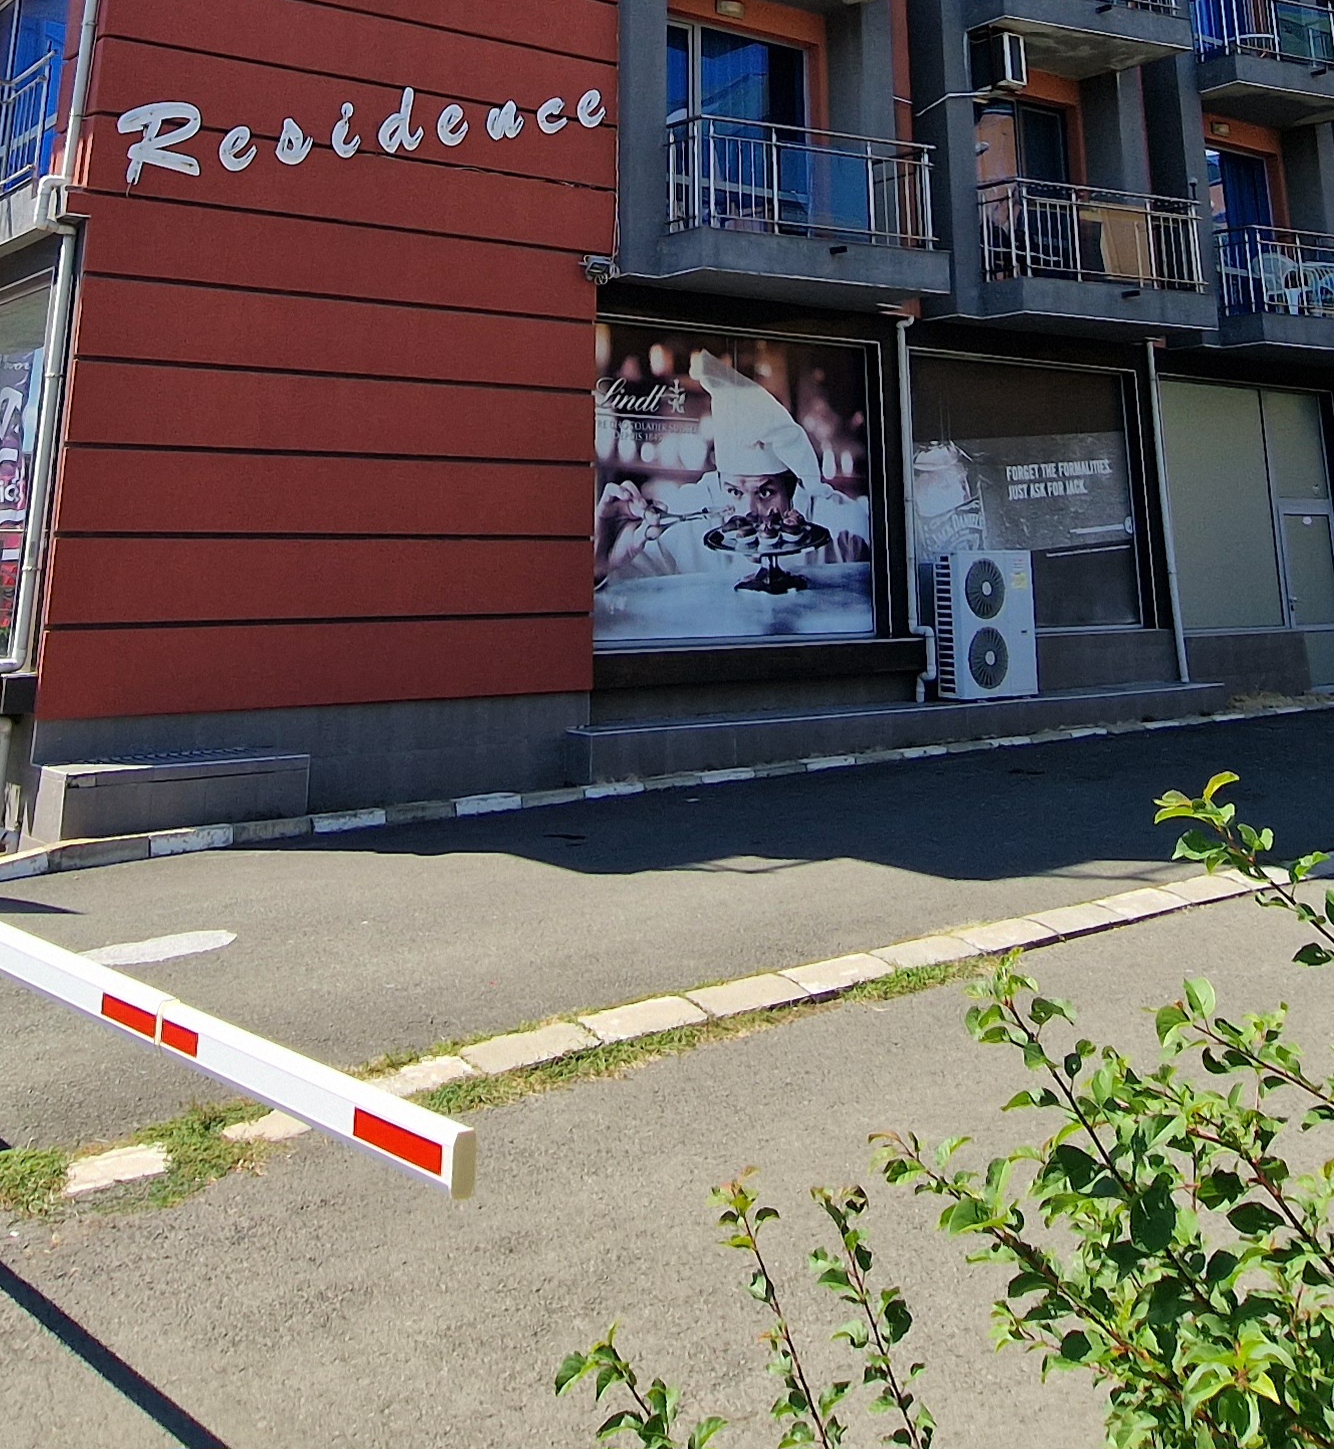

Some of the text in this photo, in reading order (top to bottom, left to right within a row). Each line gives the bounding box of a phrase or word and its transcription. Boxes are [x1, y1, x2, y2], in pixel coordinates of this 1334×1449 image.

[117, 86, 606, 184] Residence
[596, 377, 666, 412] Lindt
[1006, 463, 1039, 481] FORGET
[1040, 462, 1058, 478] THE
[1008, 484, 1028, 500] JUST
[1030, 482, 1046, 497] ASK
[1048, 480, 1065, 496] FOR
